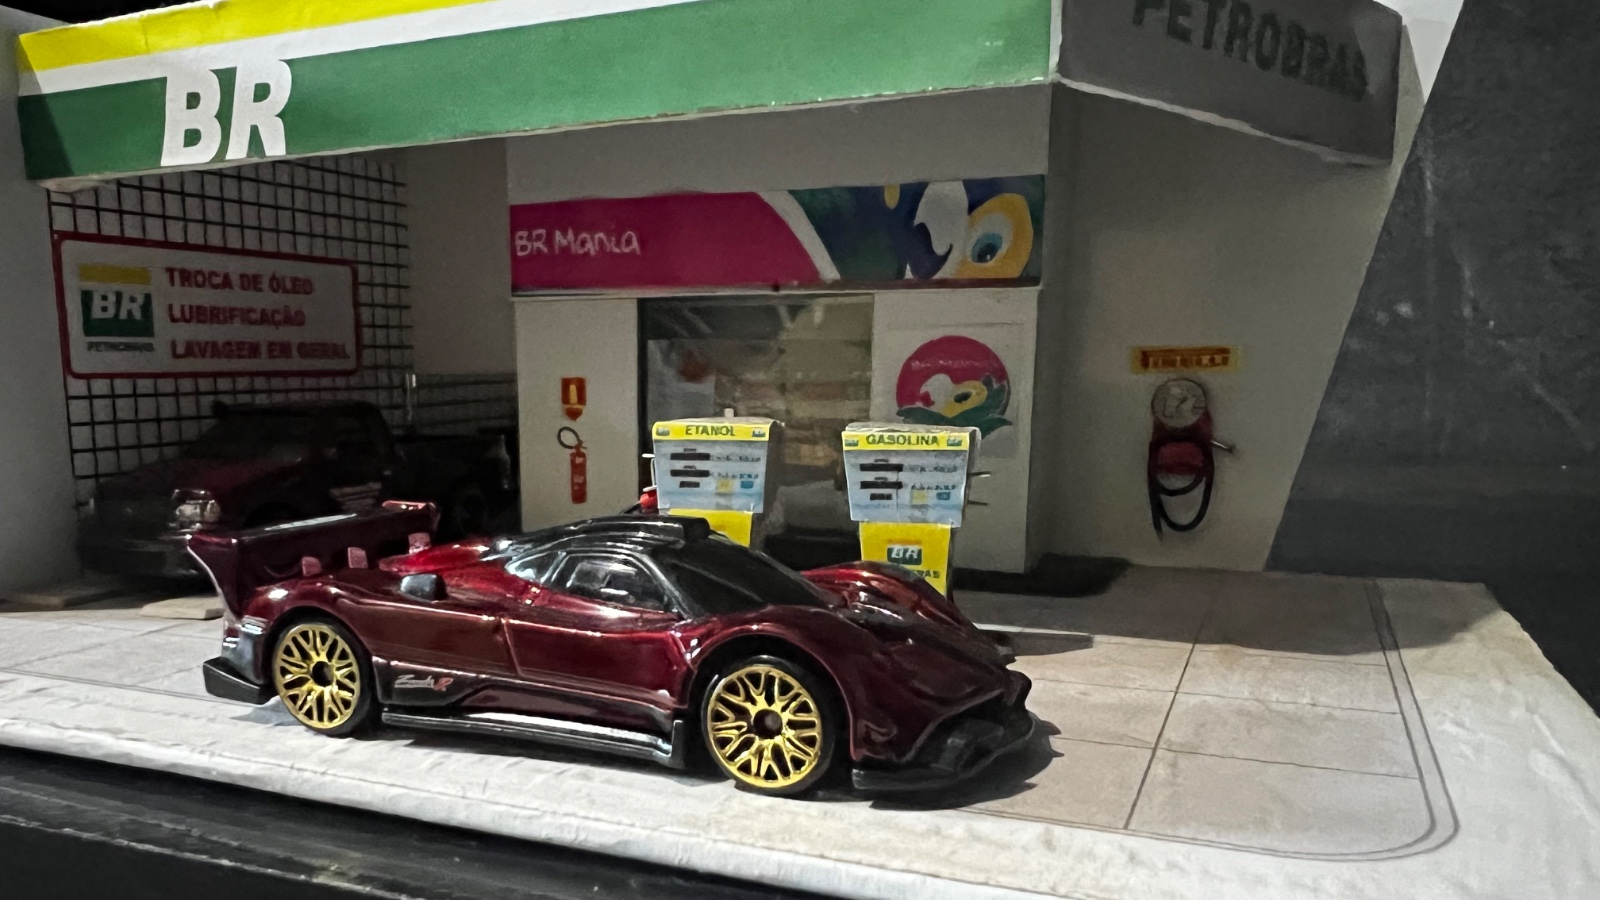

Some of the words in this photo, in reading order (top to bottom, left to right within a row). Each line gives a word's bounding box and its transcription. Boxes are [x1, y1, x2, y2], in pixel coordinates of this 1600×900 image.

[161, 59, 292, 167] BR
[514, 228, 549, 257] BR
[554, 226, 641, 257] Mania
[165, 267, 234, 290] TROCA
[239, 273, 264, 293] DE
[268, 271, 314, 295] ÓLEO
[91, 290, 146, 320] BR
[168, 303, 307, 329] LUBRIFICAÇÃO
[170, 339, 262, 359] LAVAGEM
[266, 340, 294, 359] EM
[296, 341, 351, 360] GERAL
[685, 424, 736, 437] ETANOL
[866, 434, 940, 447] GASOLINA
[891, 546, 919, 559] BR
